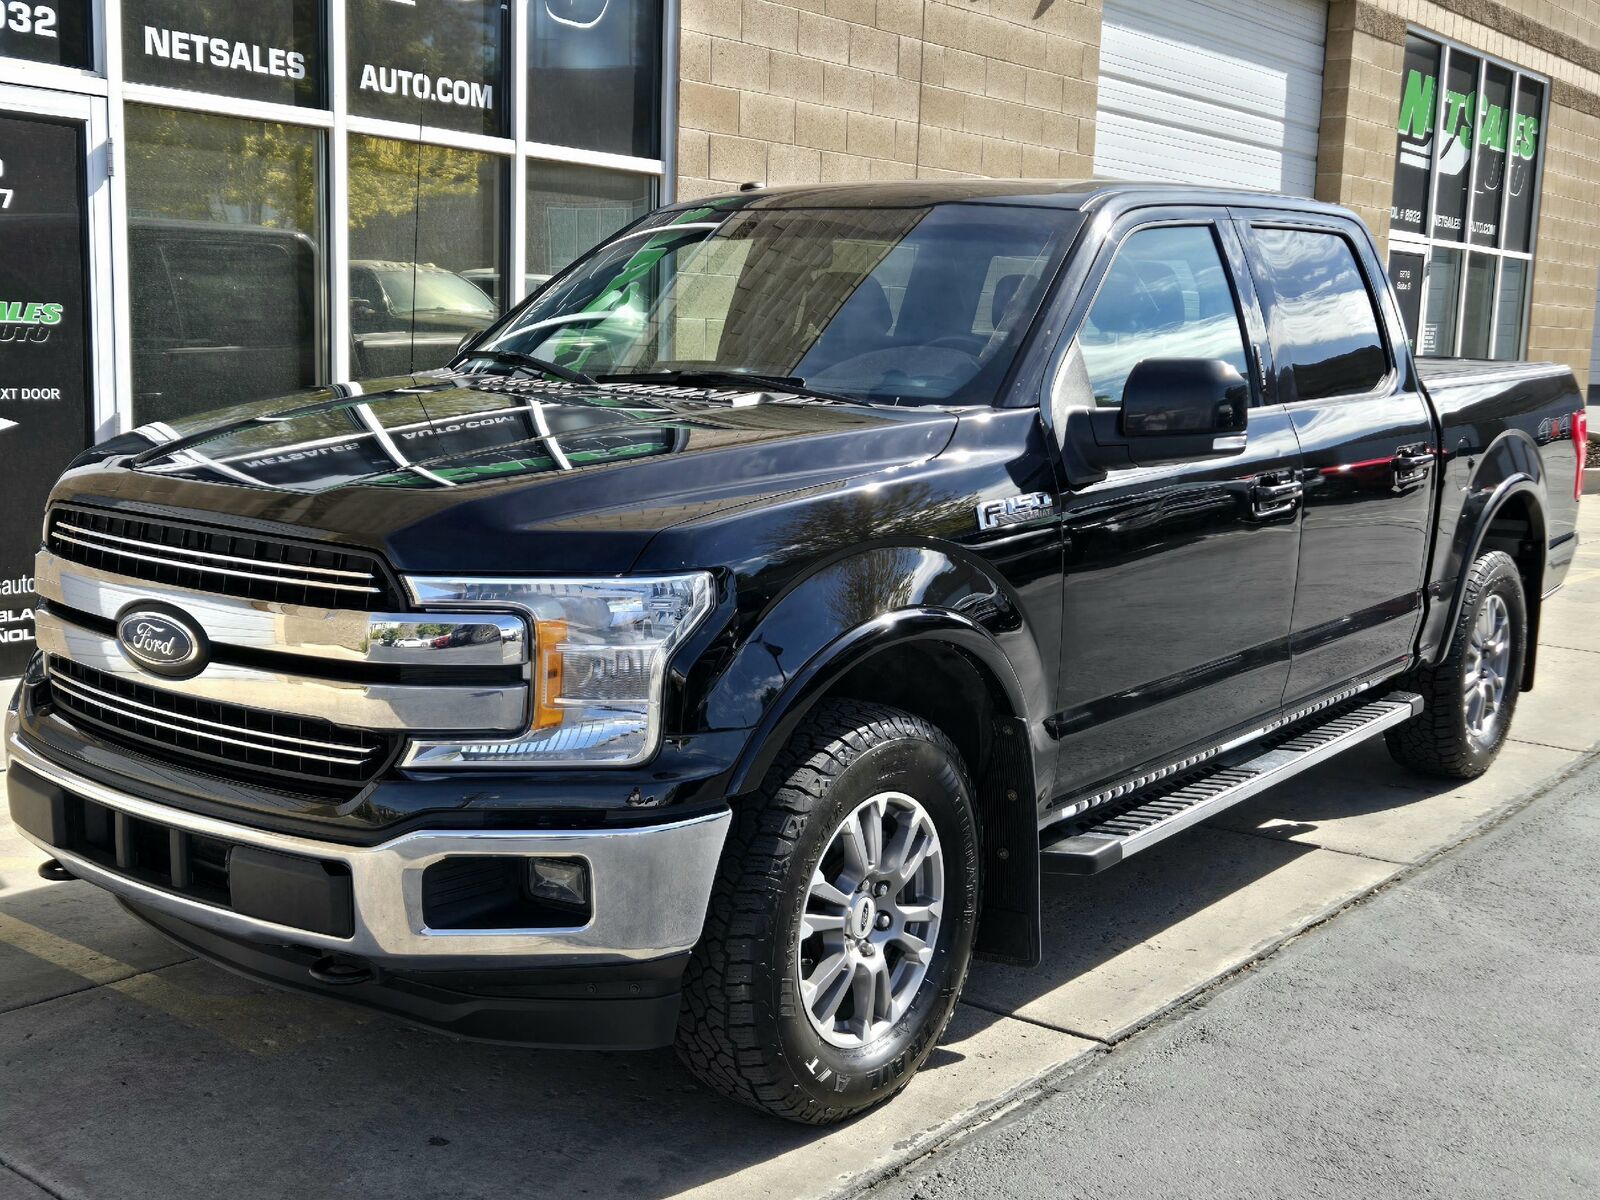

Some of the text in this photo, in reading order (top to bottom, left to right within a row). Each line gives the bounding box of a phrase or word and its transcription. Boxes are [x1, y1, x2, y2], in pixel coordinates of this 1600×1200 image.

[0, 0, 57, 38] 32
[143, 26, 306, 80] NETSALES
[359, 64, 493, 109] AUTO.COM
[21, 387, 61, 400] DOOR
[0, 574, 35, 595] auto
[133, 622, 176, 655] Ford
